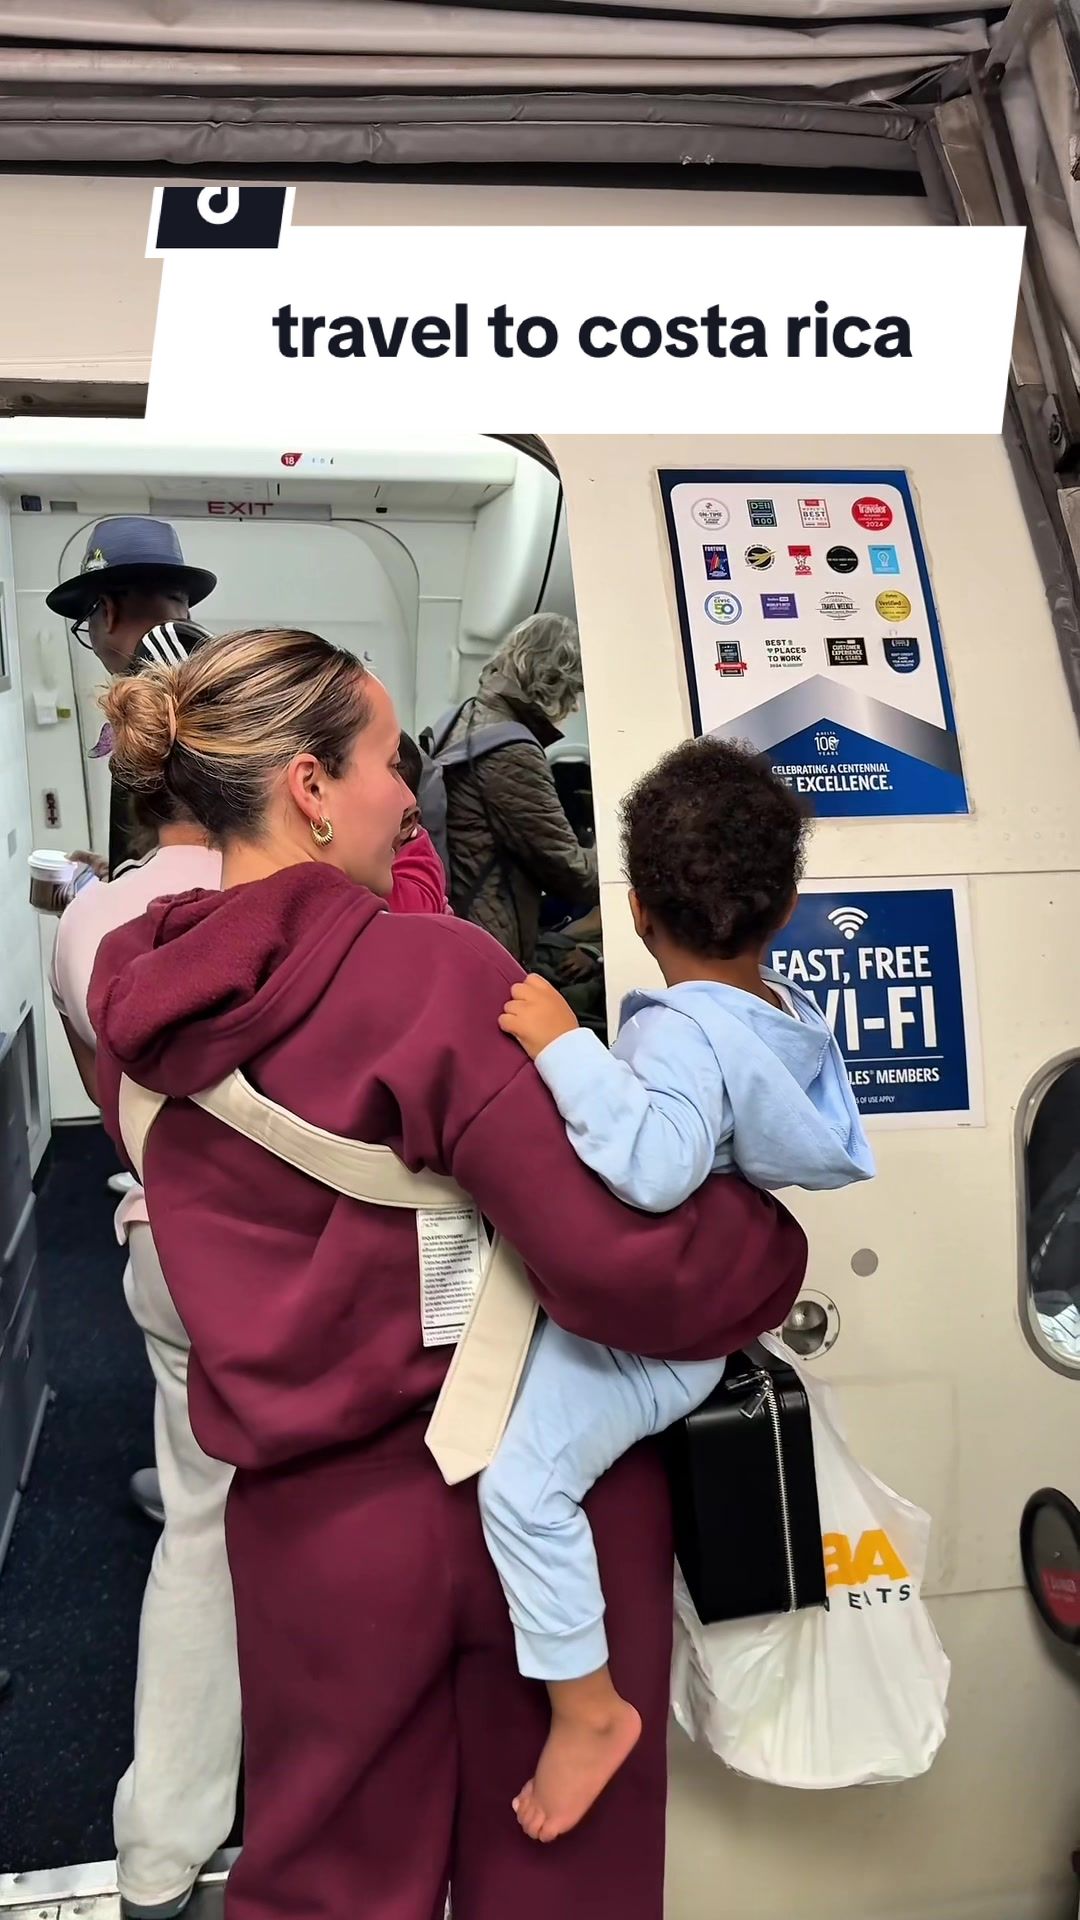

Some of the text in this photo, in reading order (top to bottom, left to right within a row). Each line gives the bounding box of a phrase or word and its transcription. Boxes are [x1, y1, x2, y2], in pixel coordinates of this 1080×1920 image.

[285, 456, 295, 465] 18
[208, 501, 274, 516] EXIT
[714, 603, 734, 615] 50
[838, 602, 854, 610] WEEKLY
[814, 736, 838, 751] 100
[771, 763, 890, 775] CELEBRATING A CENTENNIAL
[797, 775, 893, 793] EXCELLENCE.
[771, 945, 932, 984] FAST, FREE
[876, 1067, 940, 1084] MEMBERS
[860, 1096, 867, 1104] OF
[879, 1095, 895, 1103] APPLY
